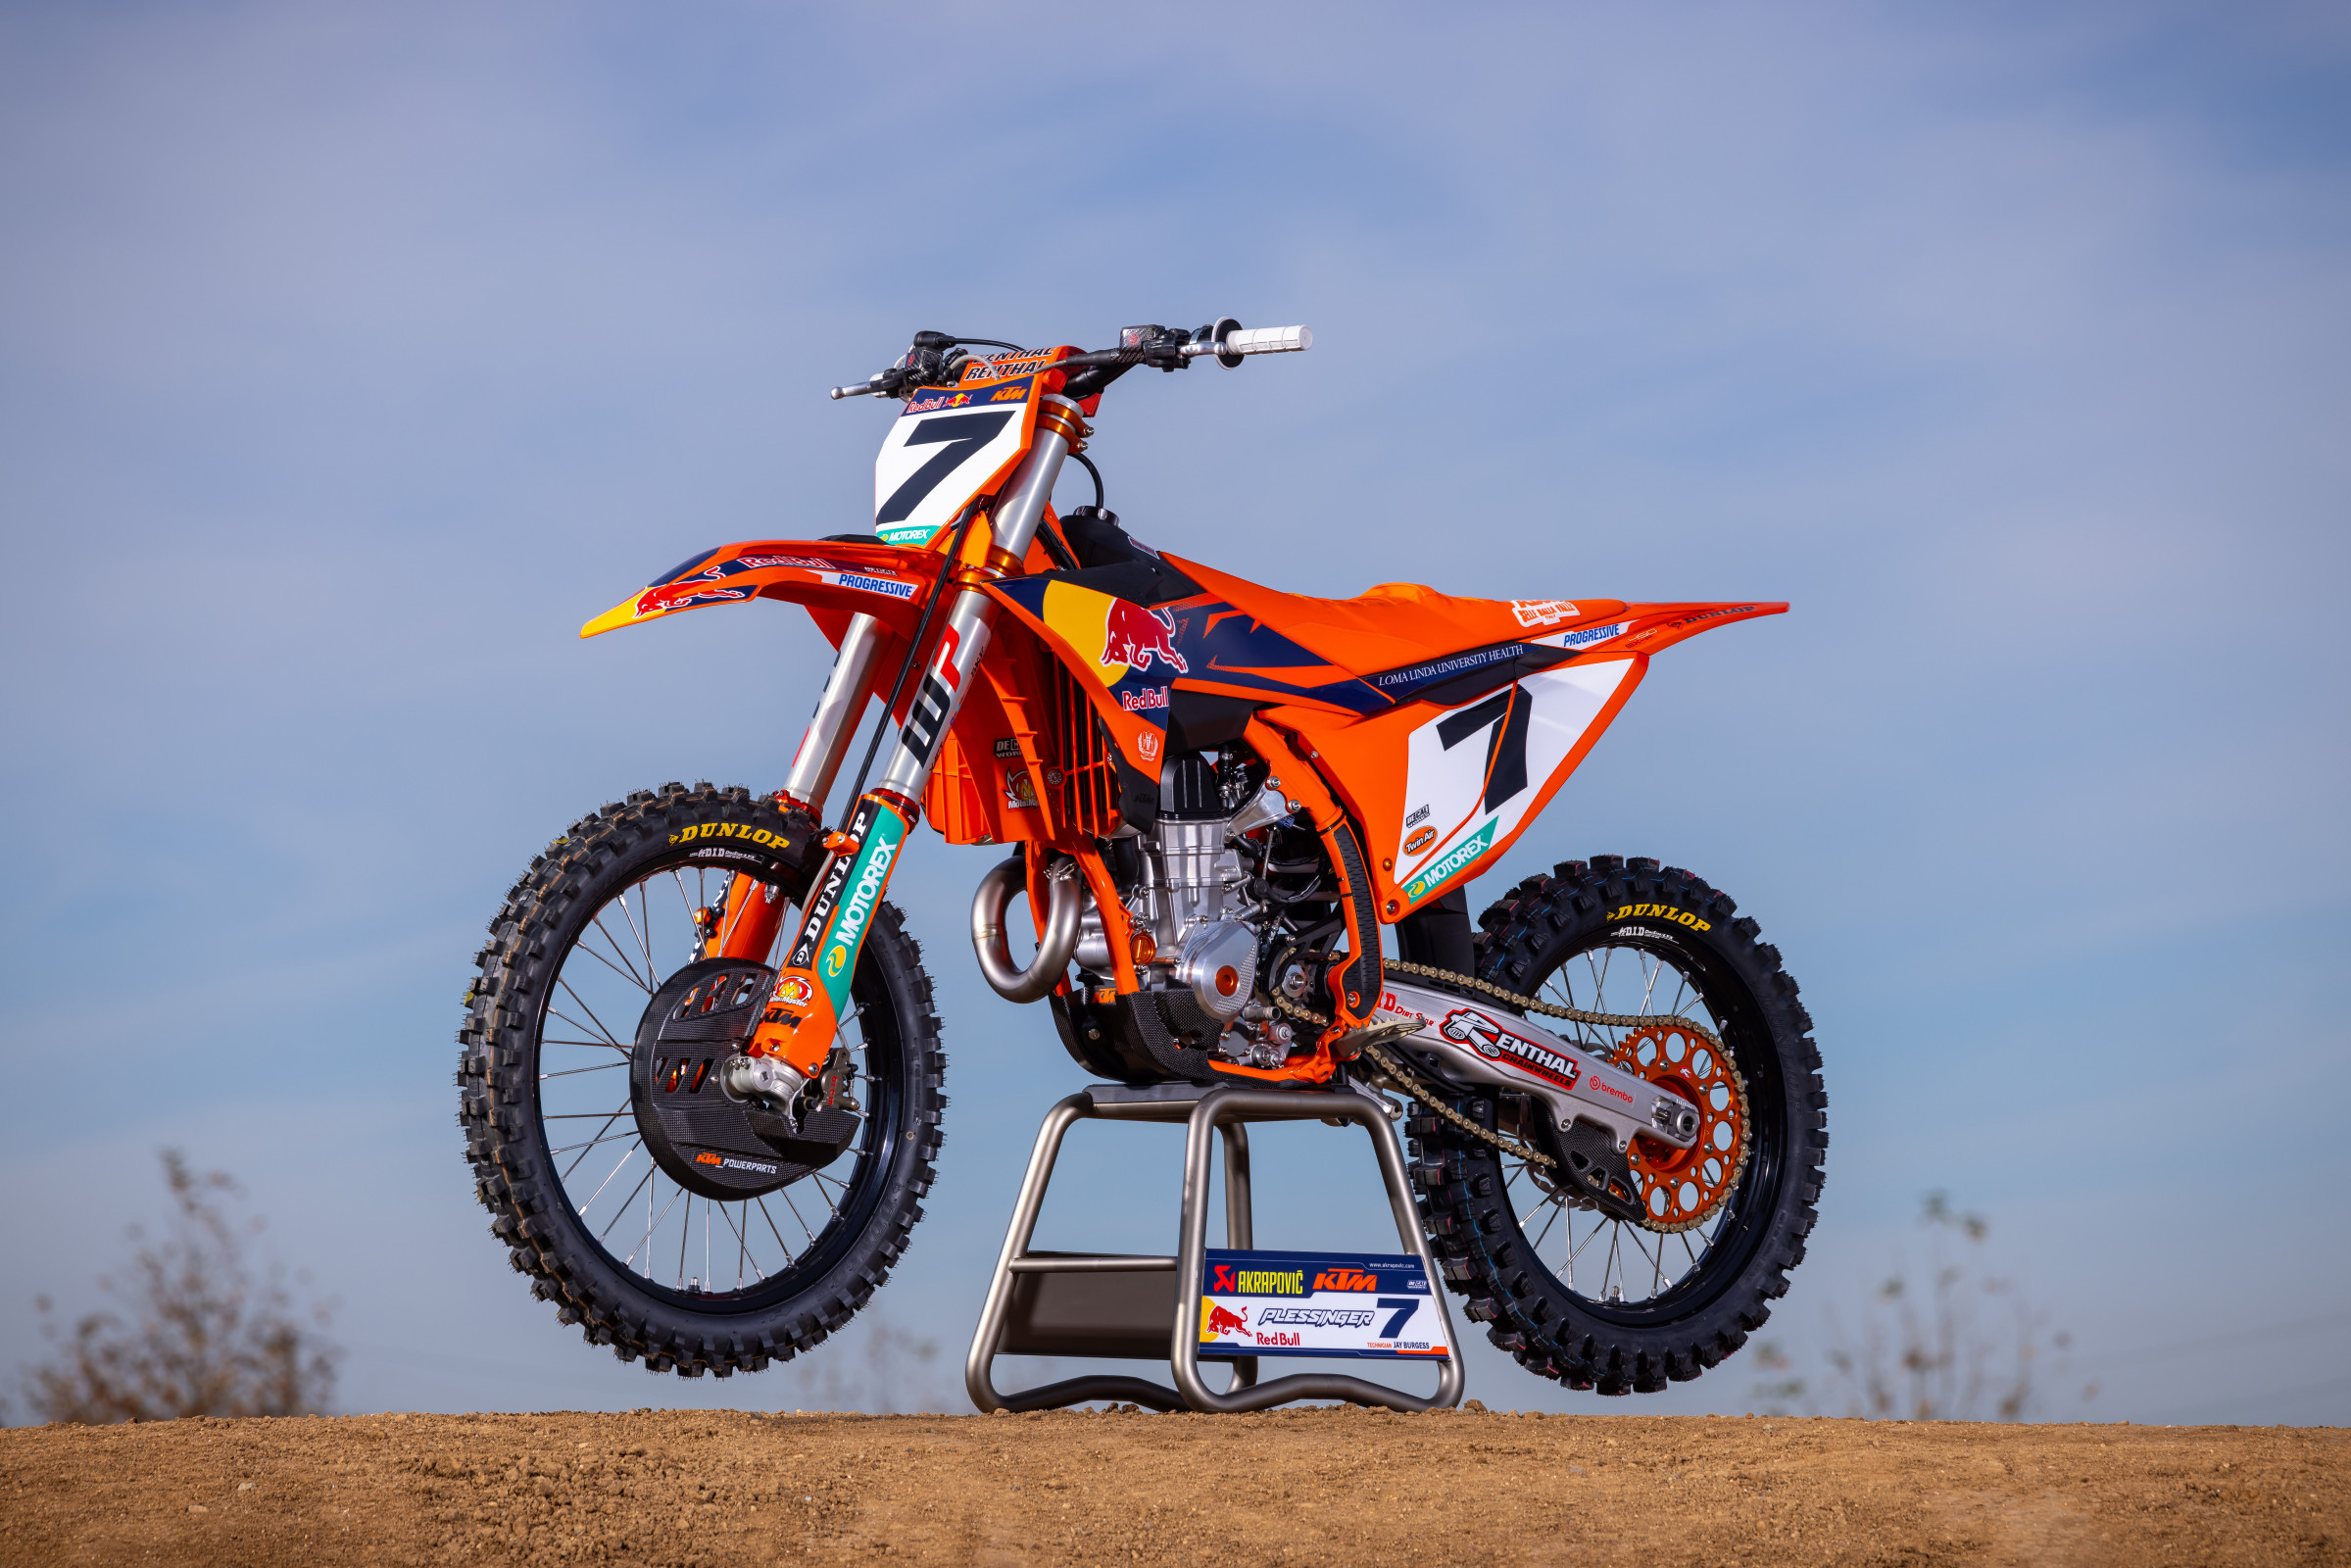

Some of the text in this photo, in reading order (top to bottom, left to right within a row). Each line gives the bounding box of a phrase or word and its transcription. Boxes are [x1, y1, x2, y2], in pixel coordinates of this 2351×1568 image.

[906, 396, 945, 414] Red Bull
[989, 386, 1027, 402] KTM
[875, 410, 1015, 524] 7
[888, 529, 930, 542] MOTOREX
[736, 556, 836, 569] Red Bull
[839, 573, 911, 598] PROGRESSIVE
[1683, 605, 1755, 624] DUNLOP
[1563, 623, 1620, 648] PROGRESSIVE
[1379, 644, 1523, 687] LOMA LINDA UNIVERSITY HEALTH
[1122, 686, 1169, 711] Red Bull
[1436, 683, 1533, 815] 7
[679, 822, 790, 850] DUNLOP
[1405, 829, 1435, 854] Twin Air
[1424, 835, 1489, 888] MOTOREX
[835, 836, 897, 947] MOTOREX
[1615, 903, 1712, 932] DUNLOP
[759, 1007, 804, 1029] KTM
[1501, 1054, 1572, 1087] CHAINWHEELS
[1601, 1082, 1634, 1103] brembo
[696, 1152, 721, 1165] KTM
[1312, 1268, 1378, 1292] KTM
[1258, 1307, 1375, 1329] PLESSINGER
[1376, 1298, 1420, 1339] 7
[1256, 1332, 1300, 1346] Red Bull
